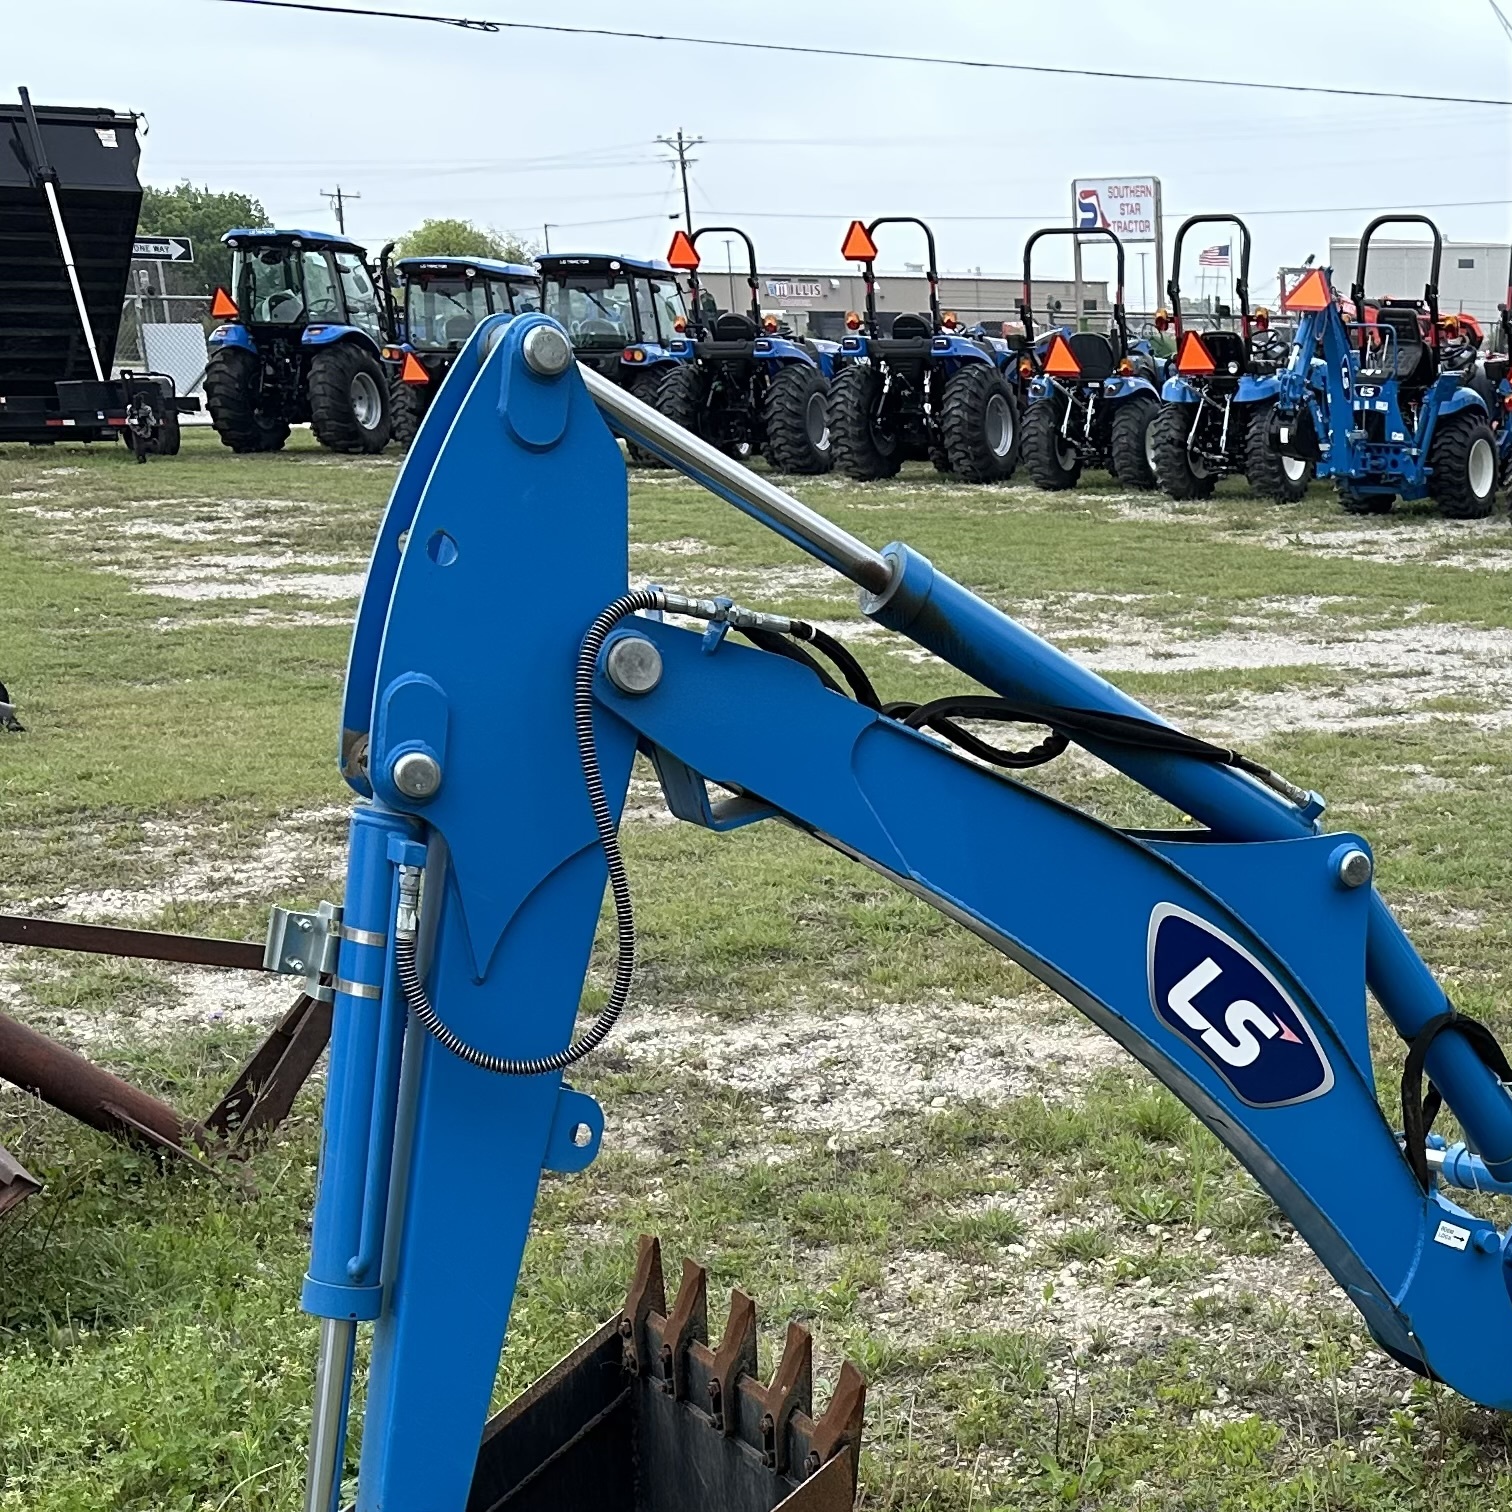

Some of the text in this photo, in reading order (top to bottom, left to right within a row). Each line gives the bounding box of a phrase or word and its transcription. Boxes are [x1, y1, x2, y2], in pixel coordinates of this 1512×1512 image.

[1107, 185, 1152, 199] SOUTHERN
[1119, 203, 1141, 216] STAR
[1111, 220, 1151, 233] TRACTOR
[133, 244, 170, 253] ONE WAY
[1360, 386, 1375, 397] LS
[1167, 956, 1280, 1067] LS
